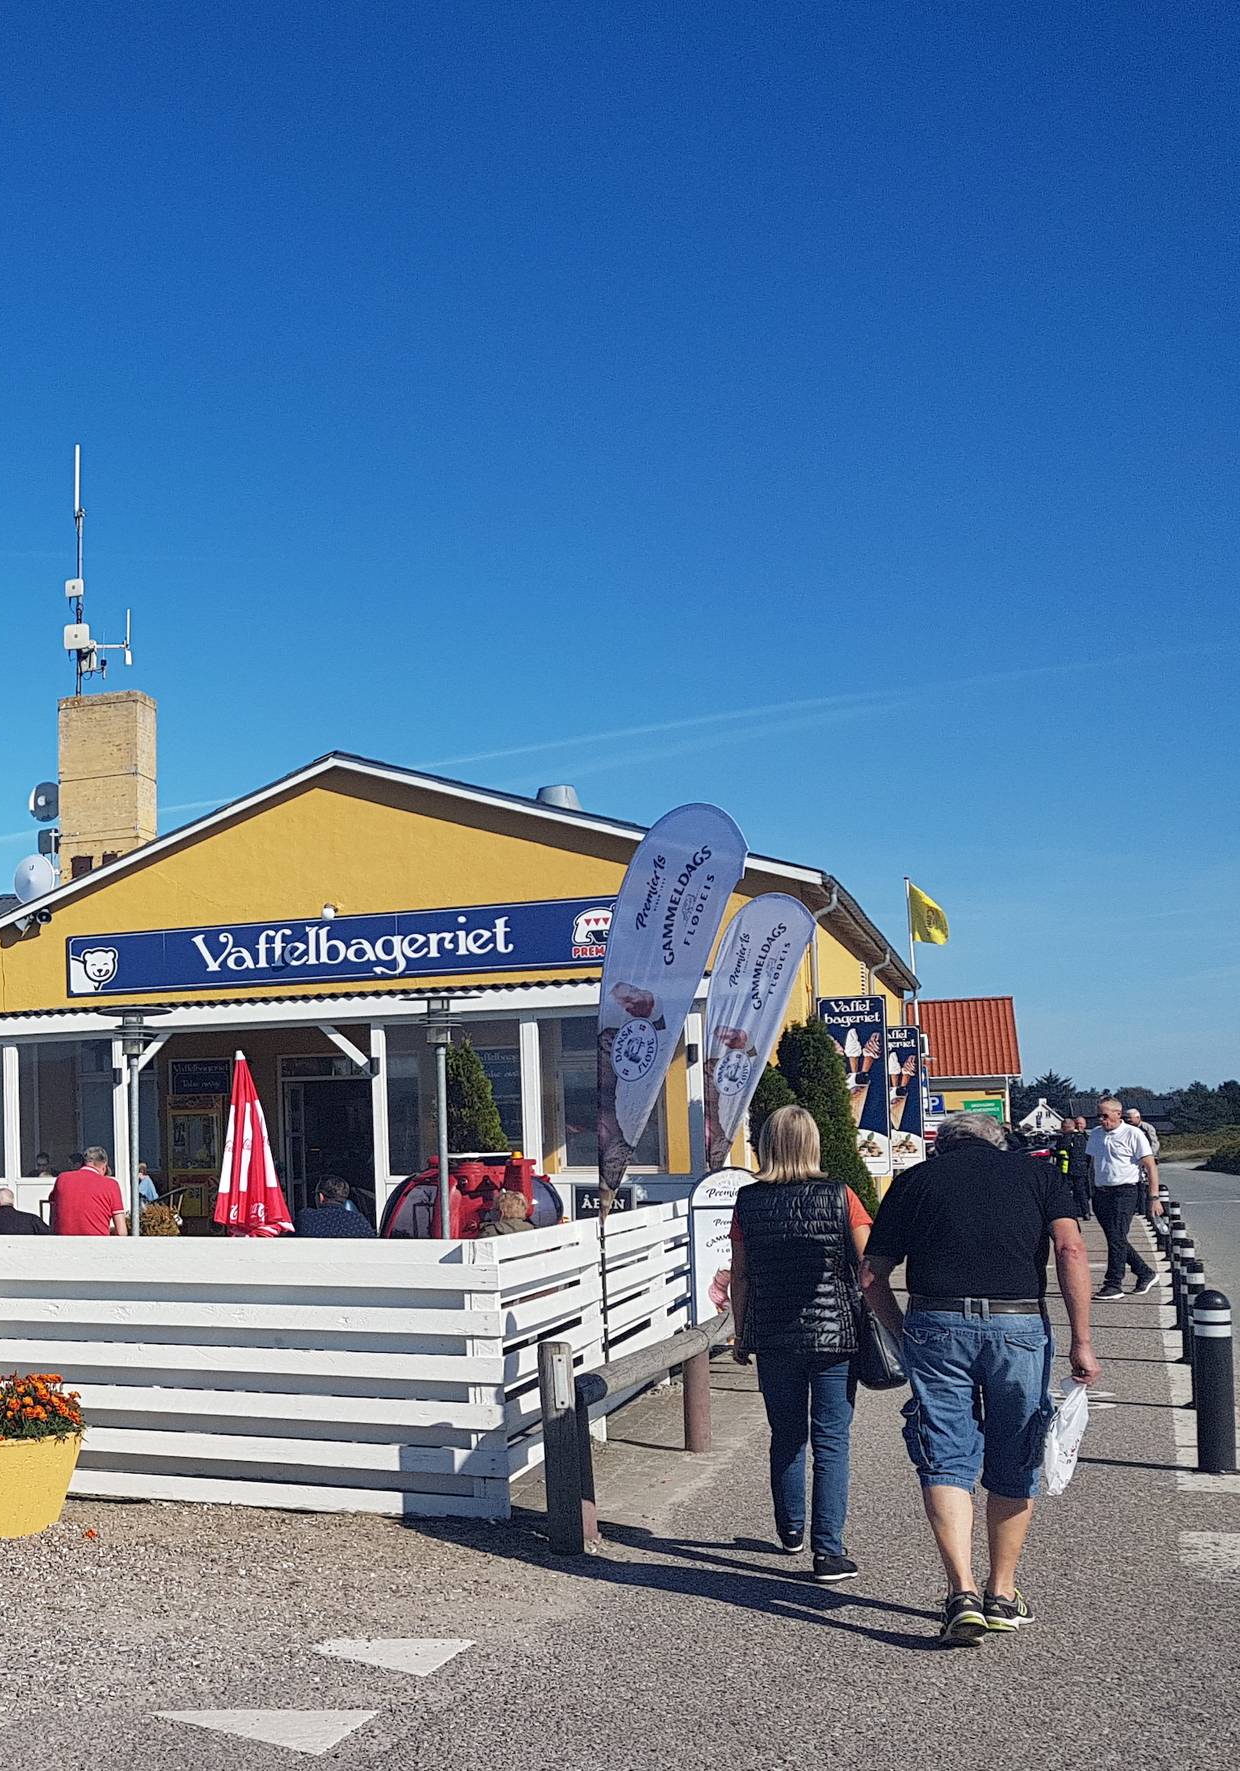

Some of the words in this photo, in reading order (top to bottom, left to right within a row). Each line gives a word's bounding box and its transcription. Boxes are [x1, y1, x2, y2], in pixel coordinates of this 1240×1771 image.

[635, 870, 661, 931] Premier
[662, 845, 712, 966] GAMMELDAGS
[683, 873, 715, 946] FLØDEIS
[191, 916, 514, 976] Vaffelbageriet
[729, 944, 747, 988] Premier
[751, 922, 787, 1010] GAMMELDAGS
[824, 1012, 881, 1028] bageriet
[830, 1000, 875, 1013] Vaffel-
[615, 1025, 633, 1063] DANSK
[929, 1097, 940, 1112] P
